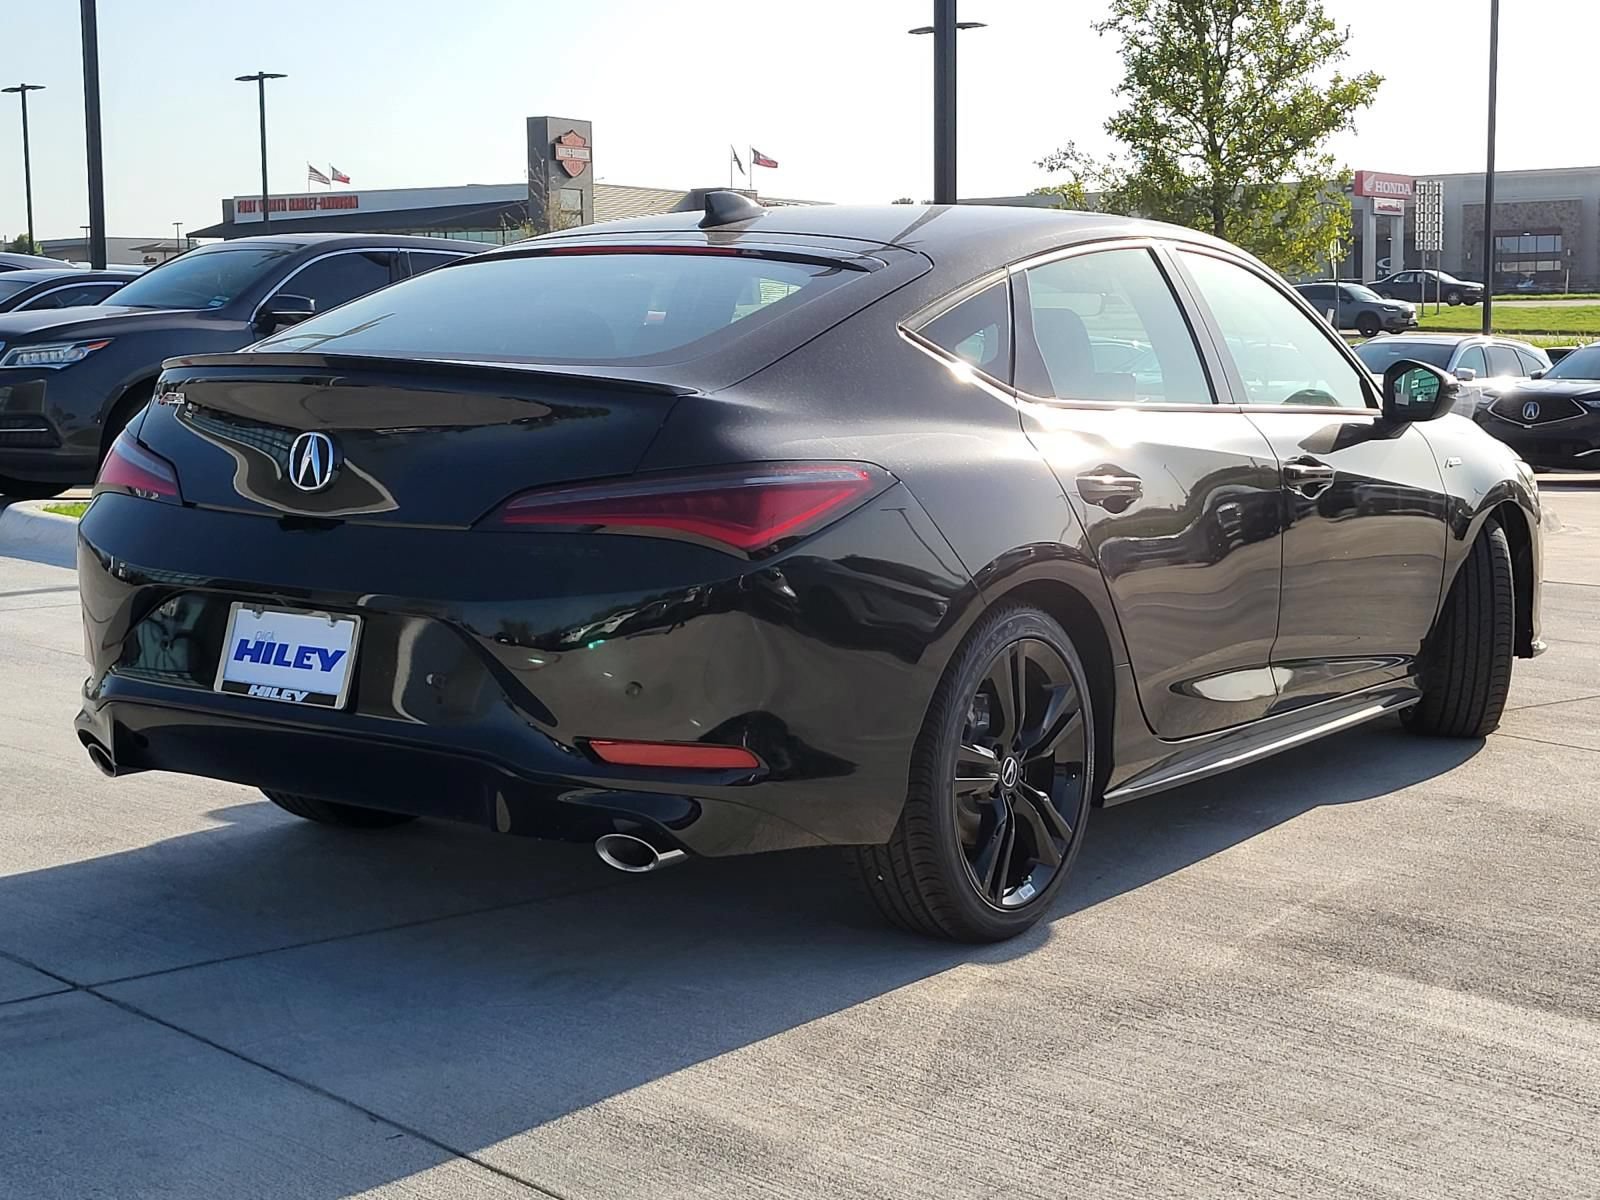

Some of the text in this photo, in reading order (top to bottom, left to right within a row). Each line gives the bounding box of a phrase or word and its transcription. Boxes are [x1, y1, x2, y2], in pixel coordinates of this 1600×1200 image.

[1375, 181, 1412, 196] HONDA
[233, 638, 346, 672] HILEY
[247, 684, 310, 701] HILEY
